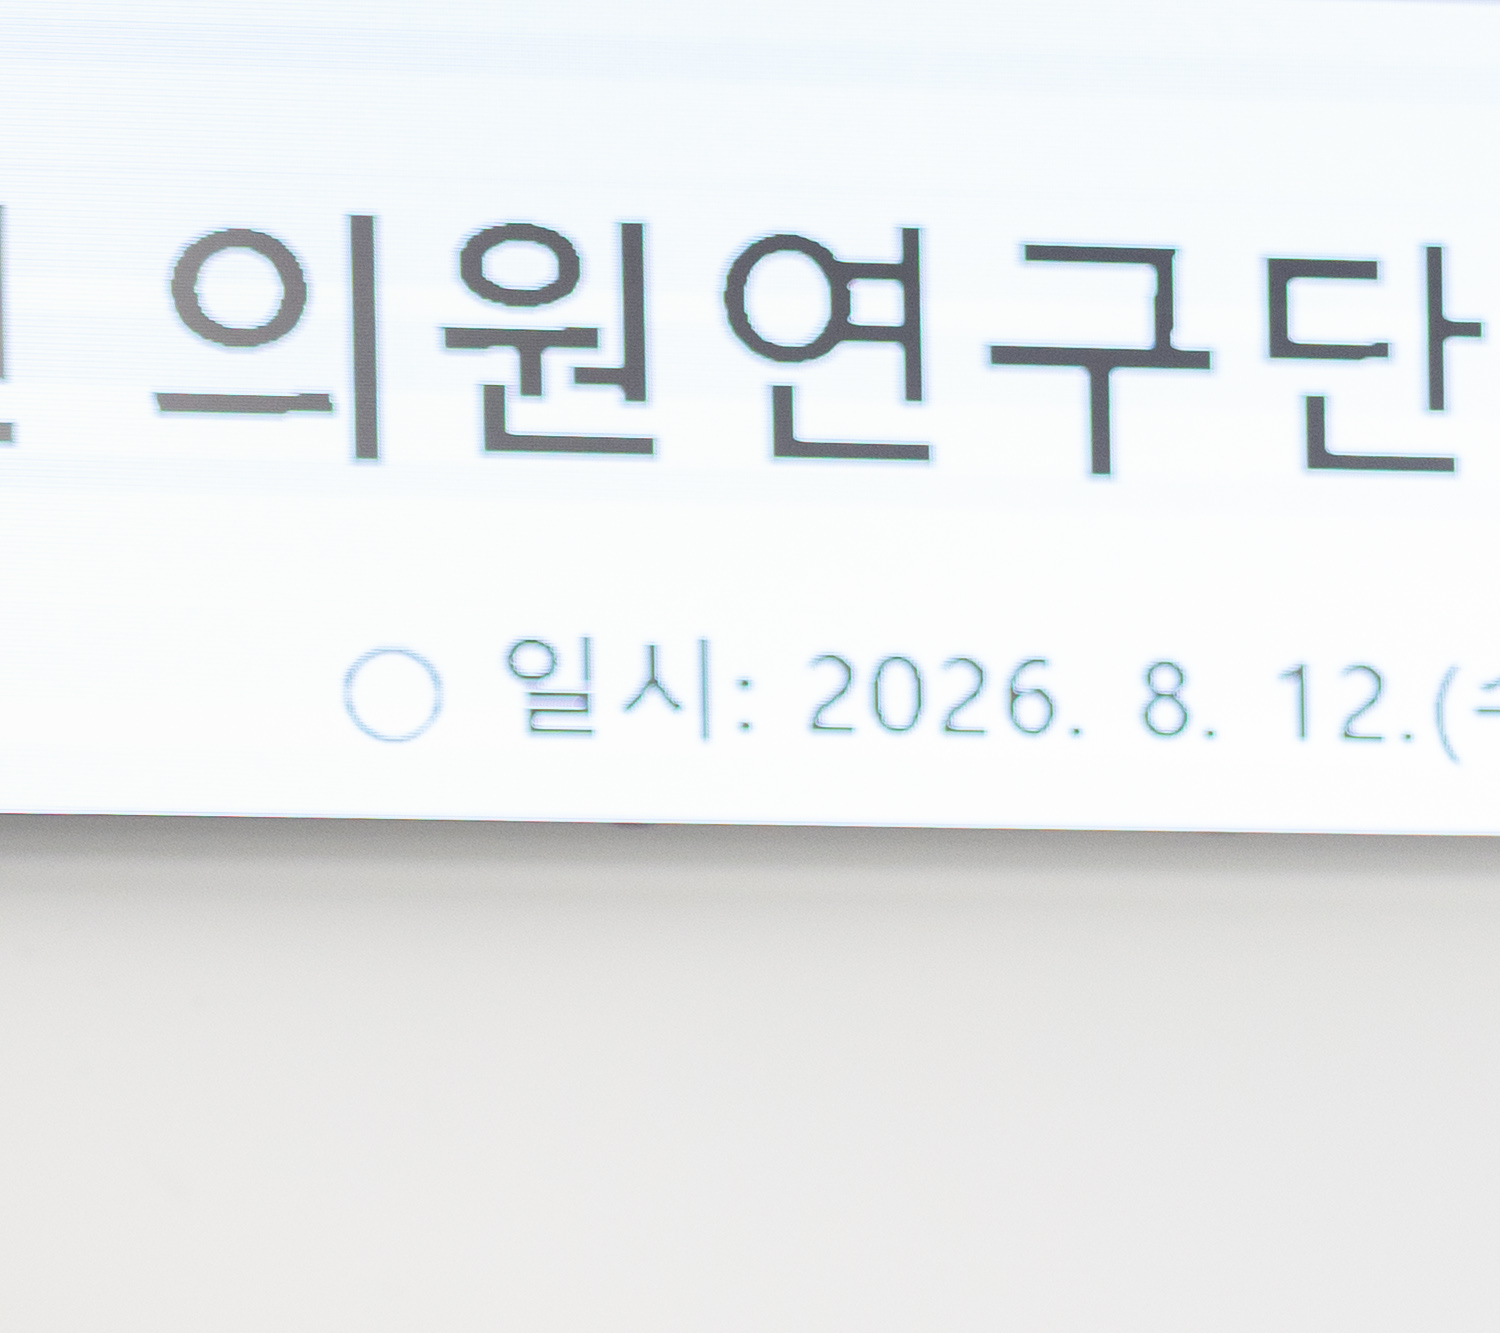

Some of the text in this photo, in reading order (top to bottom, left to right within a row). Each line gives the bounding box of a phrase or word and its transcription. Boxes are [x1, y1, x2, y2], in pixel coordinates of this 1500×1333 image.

[501, 636, 755, 744] 일시:
[805, 650, 1084, 740] 2026.
[1140, 657, 1218, 742] 8.
